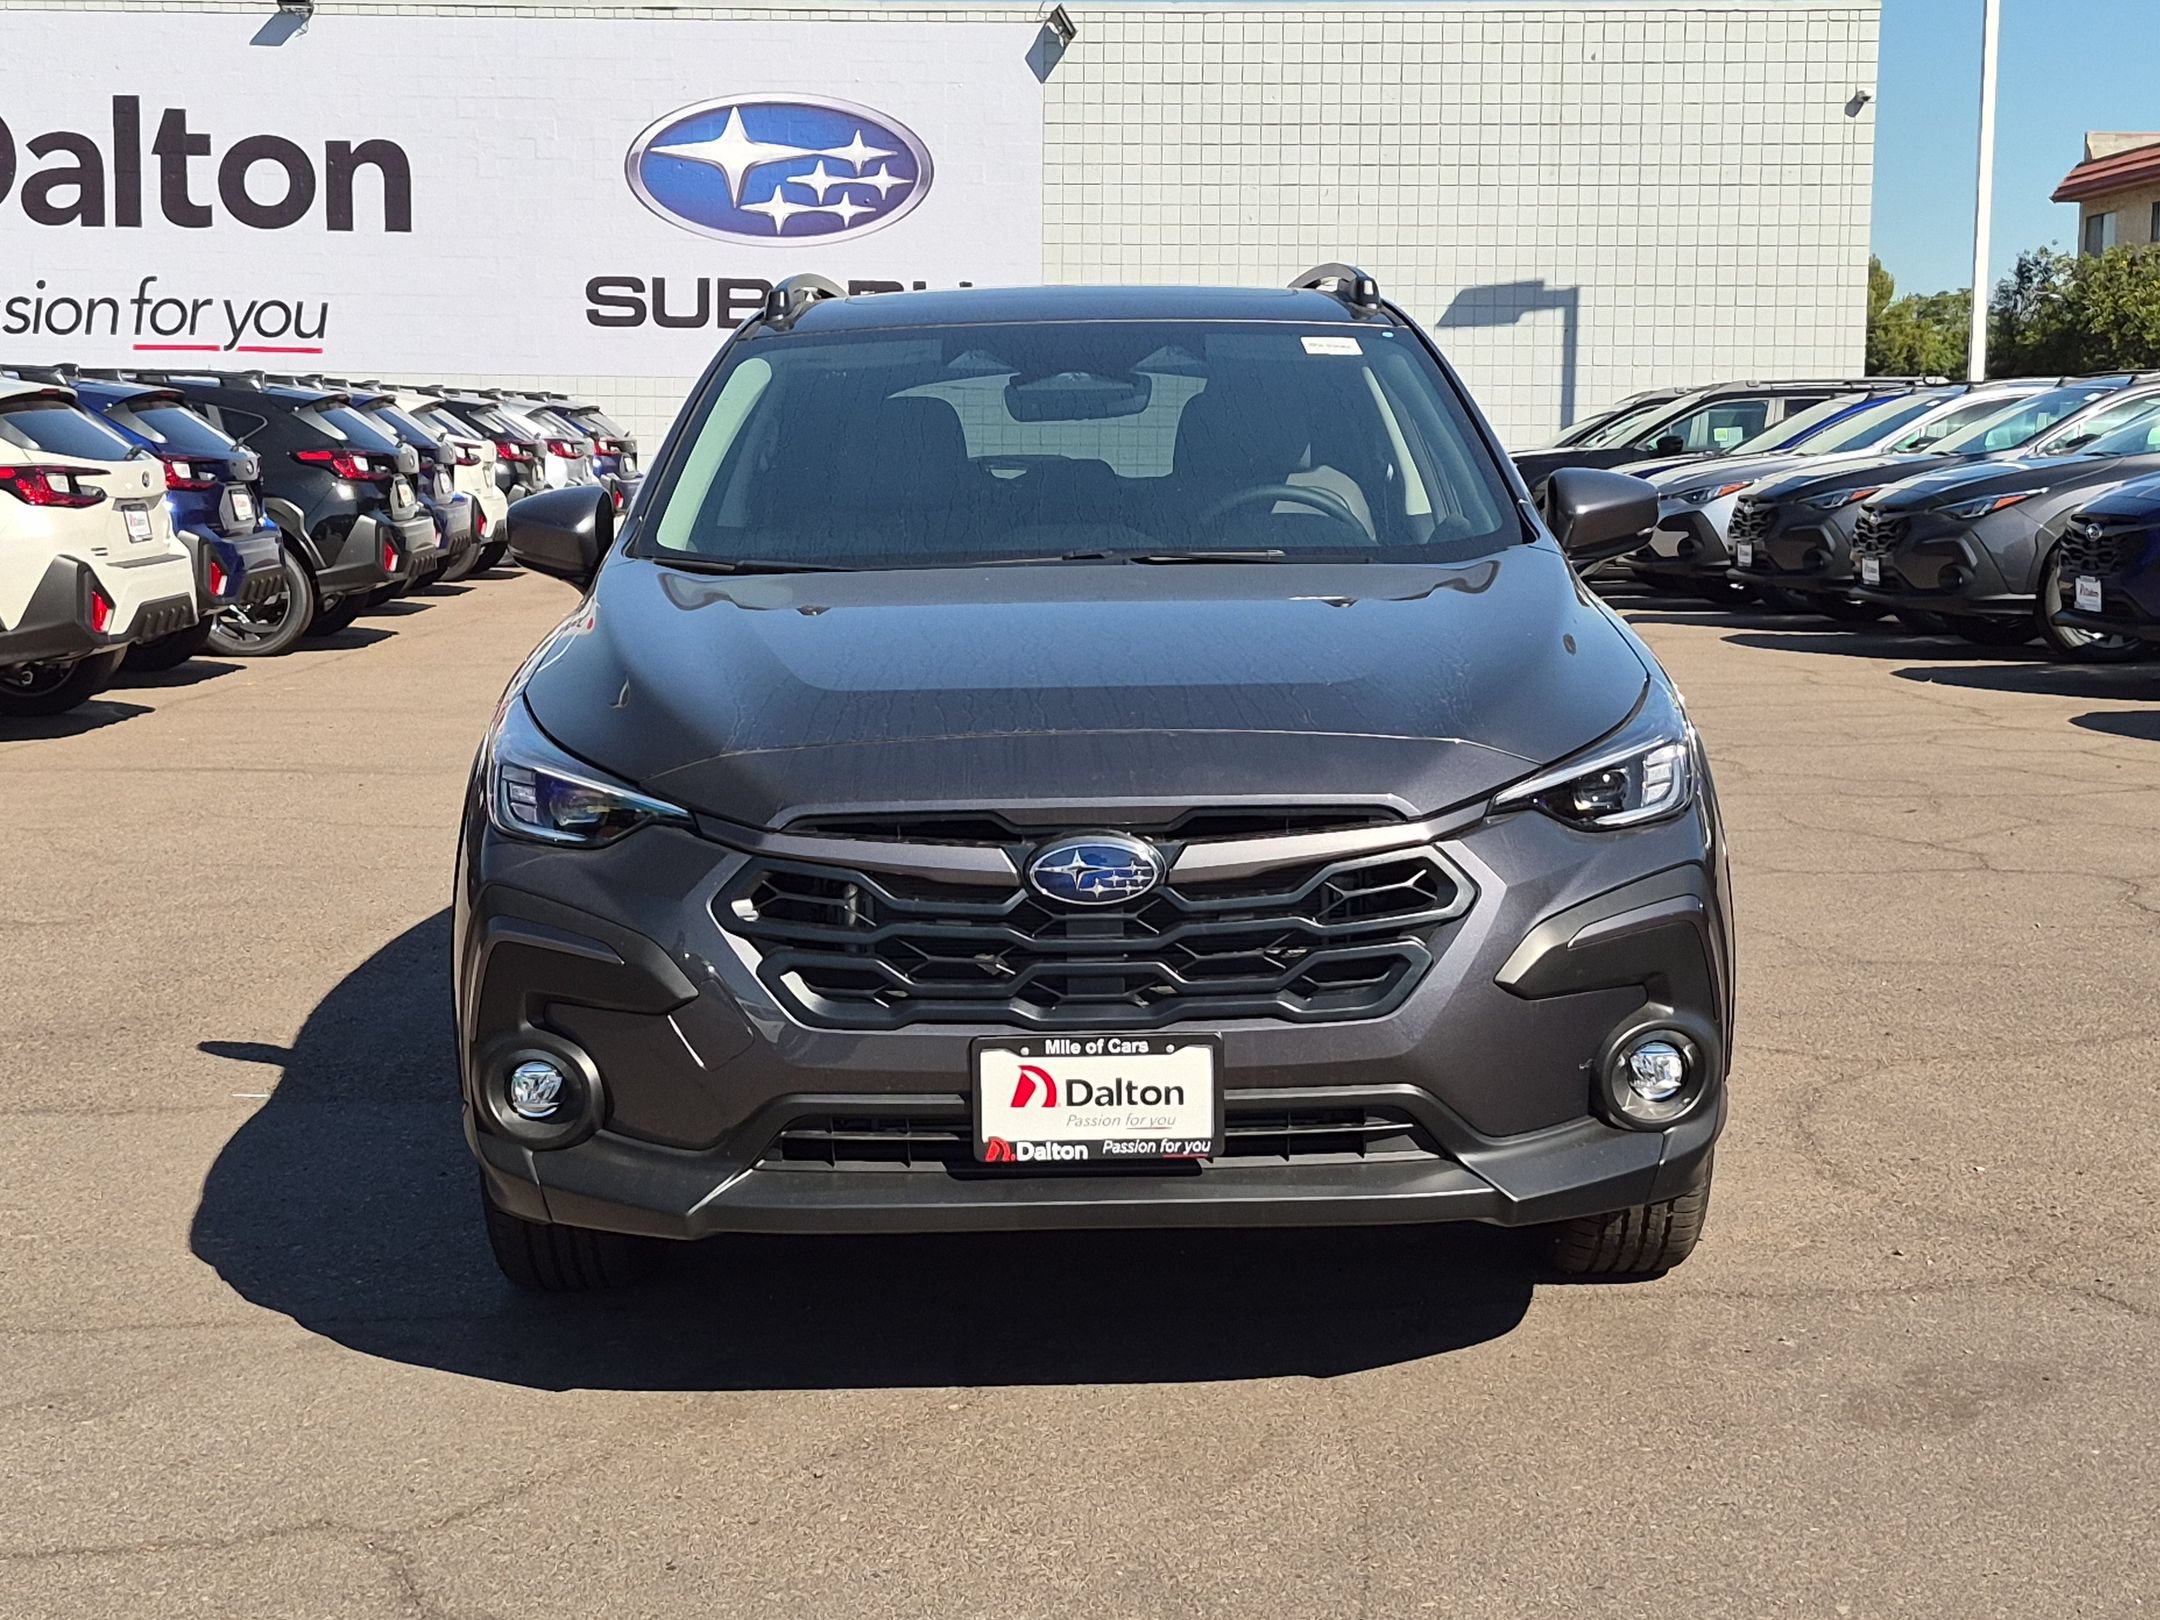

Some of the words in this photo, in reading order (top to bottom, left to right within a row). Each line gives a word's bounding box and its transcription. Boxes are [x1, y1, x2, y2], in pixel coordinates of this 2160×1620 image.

[0, 95, 412, 232] alton
[0, 279, 120, 336] sion
[130, 276, 212, 336] for
[224, 301, 328, 351] you
[1045, 1039, 1081, 1055] Mile
[1085, 1038, 1104, 1054] of
[1107, 1038, 1149, 1054] Cars
[1065, 1077, 1184, 1106] Dalton
[1066, 1114, 1121, 1127] Passion
[1125, 1112, 1146, 1126] for
[1149, 1115, 1176, 1128] you
[1016, 1141, 1089, 1161] Dalton
[1102, 1139, 1156, 1154] Passion
[1160, 1138, 1181, 1153] for
[1183, 1140, 1211, 1155] you
